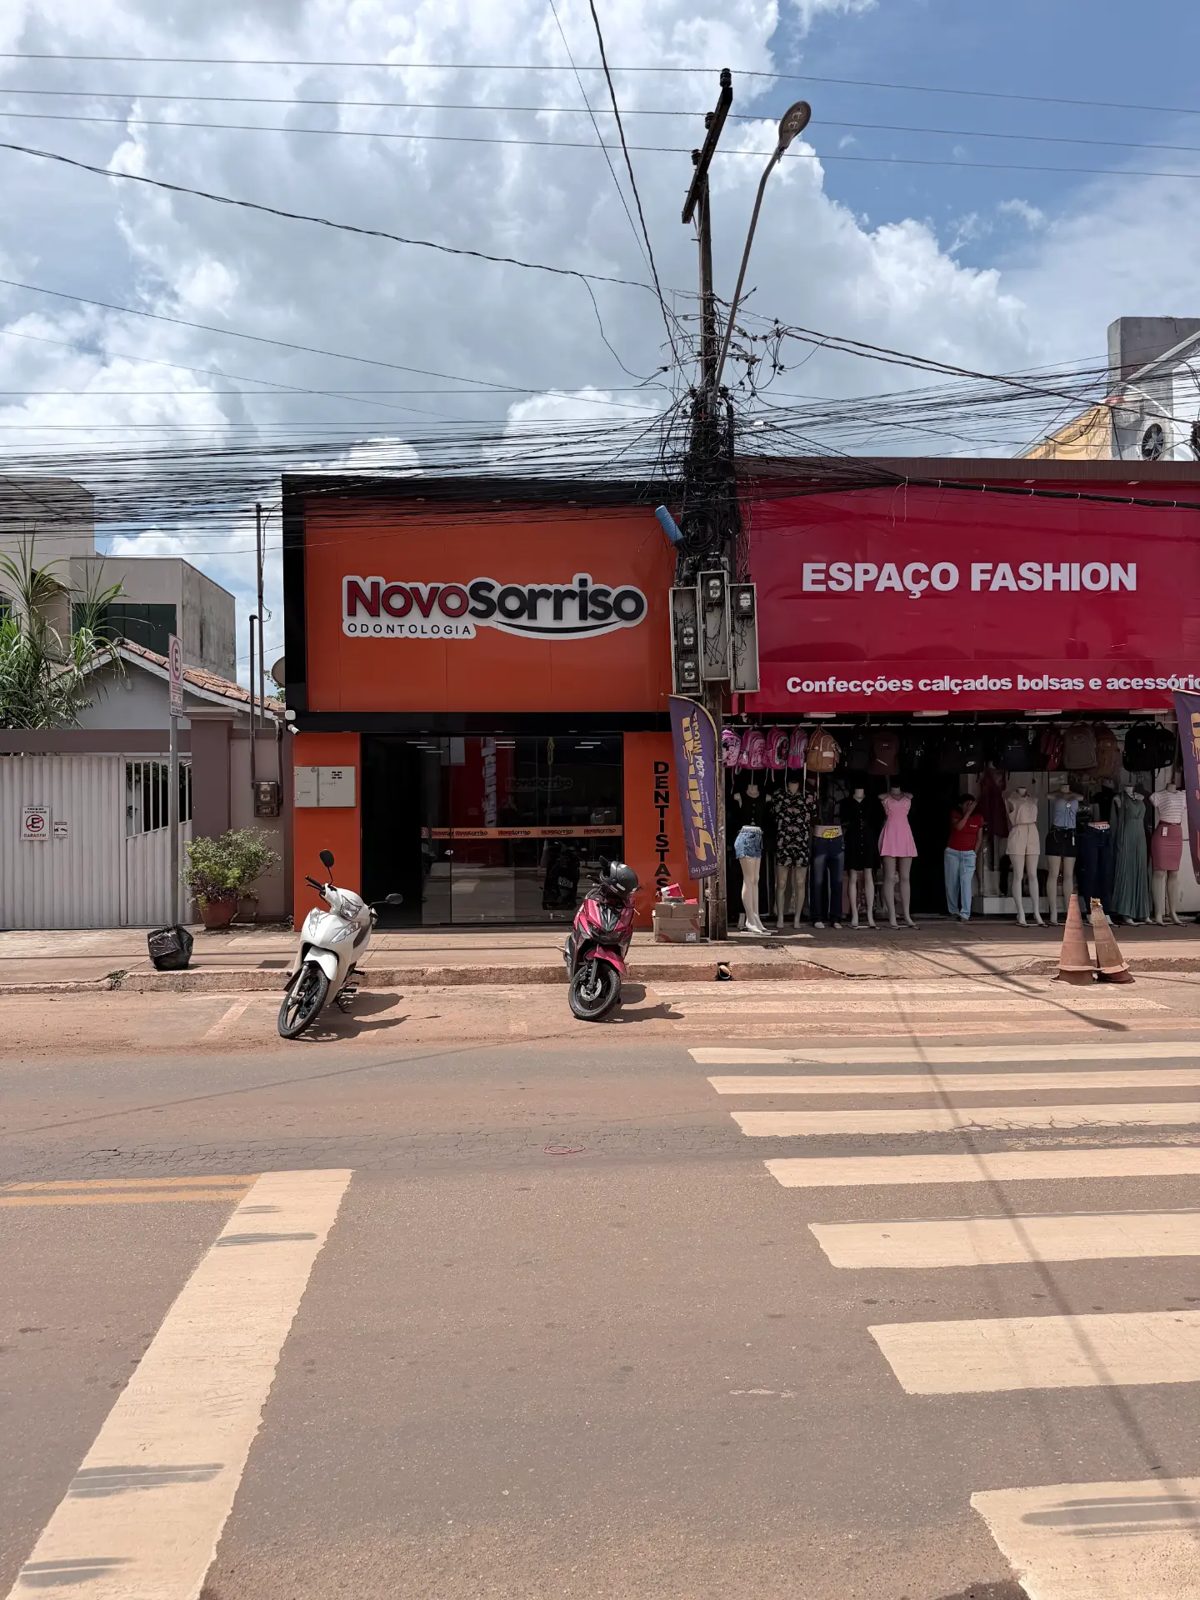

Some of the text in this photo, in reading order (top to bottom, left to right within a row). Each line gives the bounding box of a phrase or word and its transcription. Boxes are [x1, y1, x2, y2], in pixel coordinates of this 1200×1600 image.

[802, 562, 1137, 599] ESPAÇO FASHION
[347, 624, 472, 635] ODONTOLOGIA
[786, 675, 913, 696] Confecções
[918, 674, 1012, 696] calçados
[1017, 673, 1084, 691] bolsas
[1089, 677, 1102, 691] e
